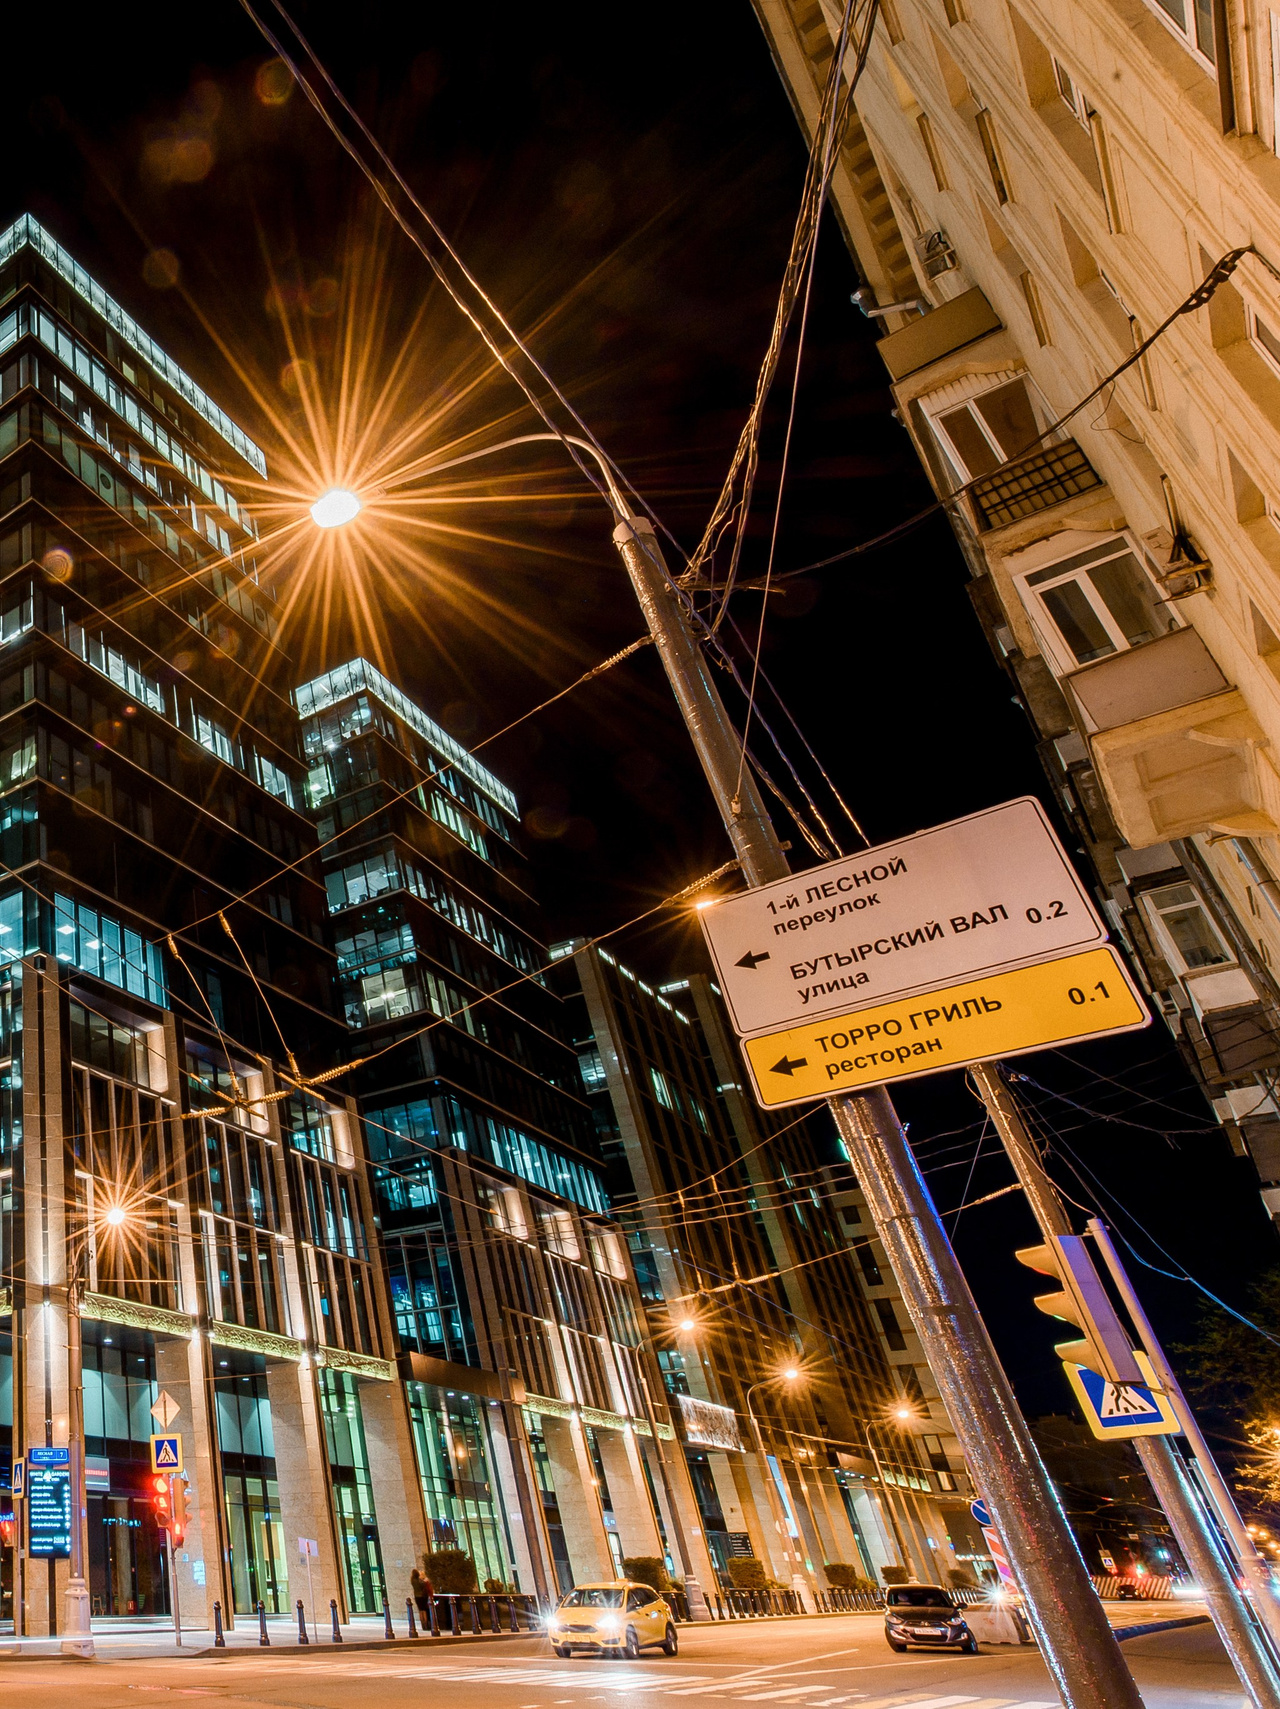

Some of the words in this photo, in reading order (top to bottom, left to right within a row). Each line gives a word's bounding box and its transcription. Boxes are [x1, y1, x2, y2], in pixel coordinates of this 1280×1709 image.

[766, 893, 801, 916] 1-й
[805, 856, 908, 903] ЛЕСНОЙ
[773, 893, 881, 936] переулок
[790, 920, 945, 980] БУТЫРСКИЙ
[950, 904, 1009, 935] ВАЛ
[1025, 900, 1069, 924] 0.2
[797, 968, 870, 1005] улица
[814, 1019, 903, 1053] ТОРРО
[908, 996, 1003, 1031] ГРИЛЬ
[1067, 981, 1110, 1006] 0.1
[825, 1035, 943, 1080] ресторан
